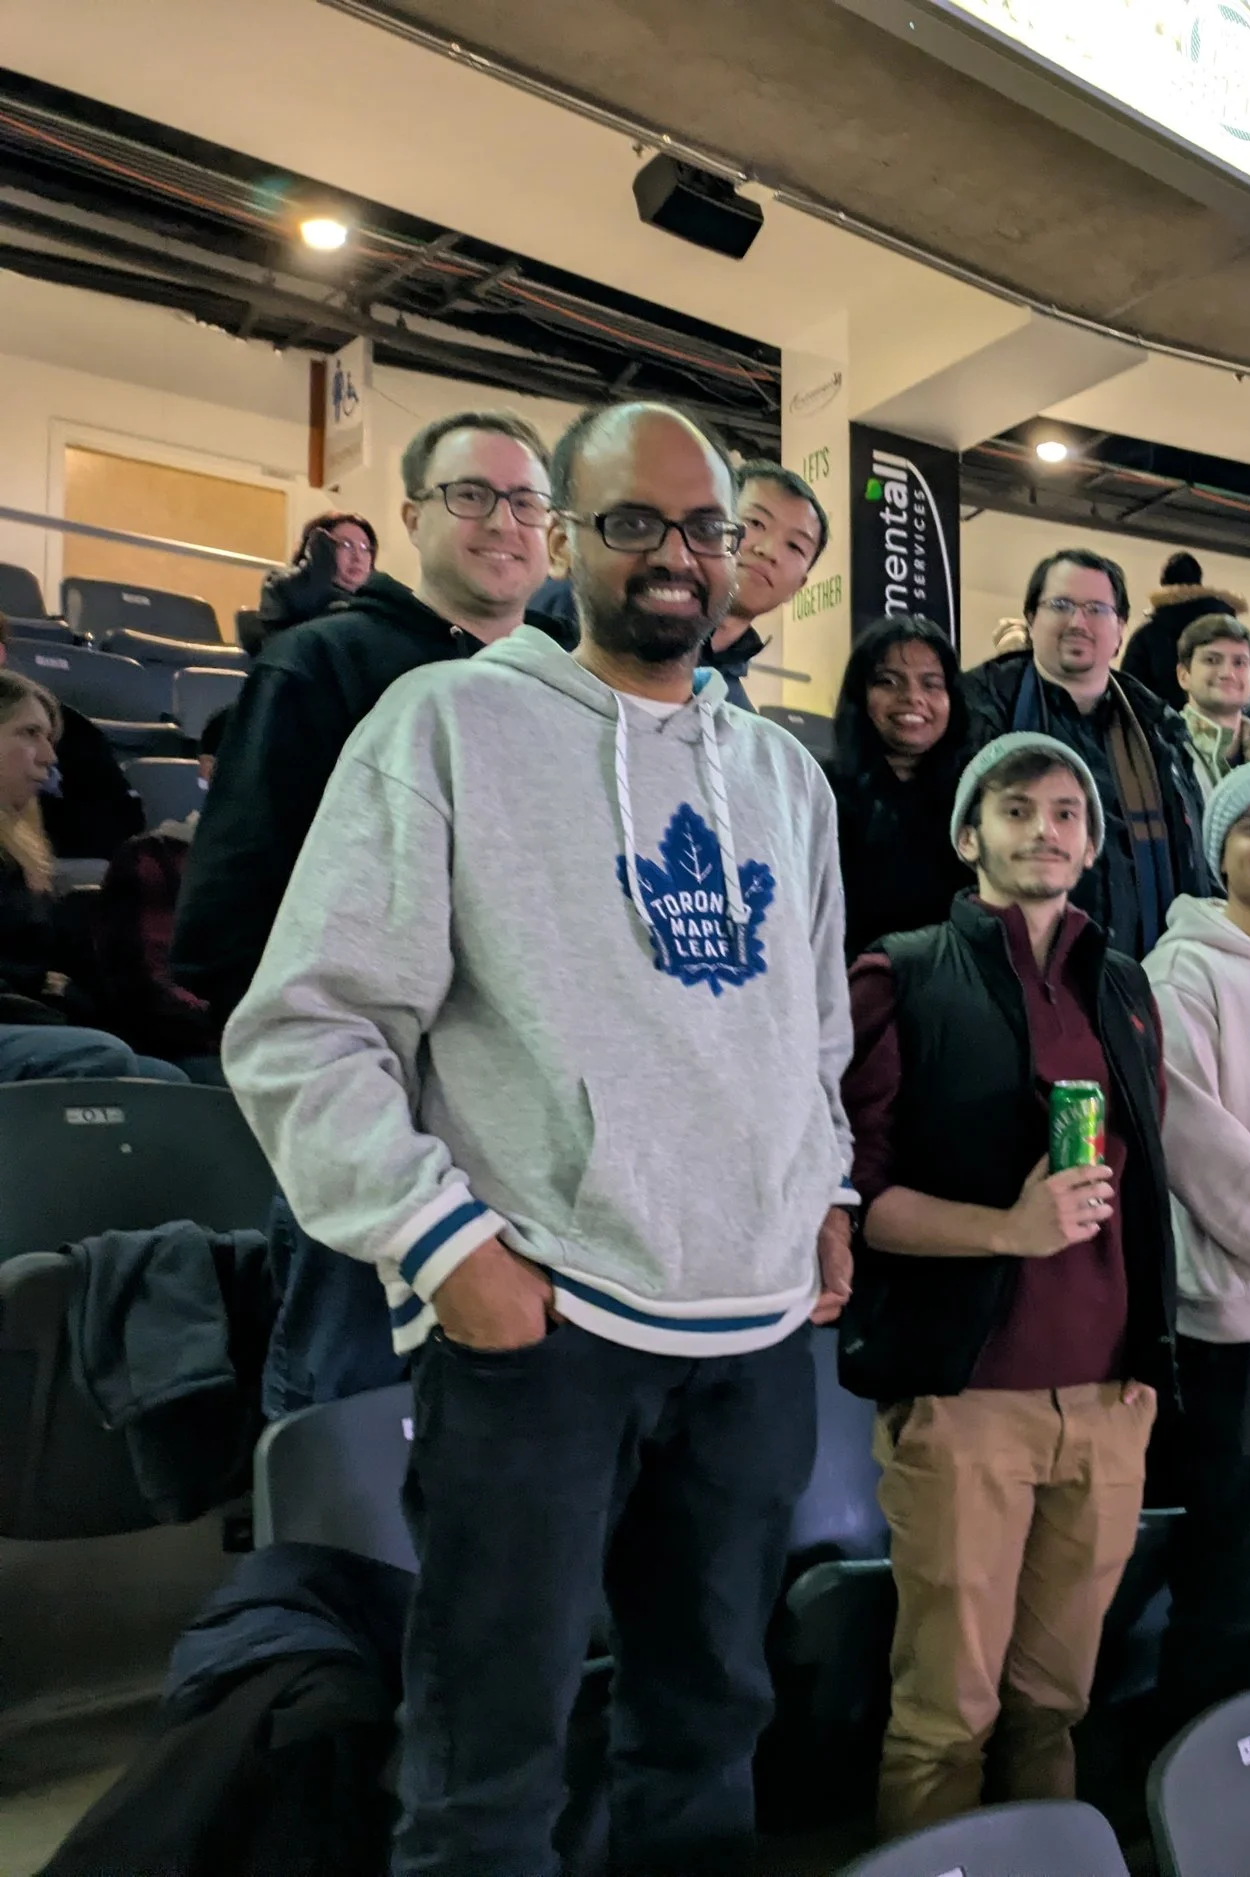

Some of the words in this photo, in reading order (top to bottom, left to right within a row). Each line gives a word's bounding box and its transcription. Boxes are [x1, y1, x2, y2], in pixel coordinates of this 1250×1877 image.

[912, 489, 927, 600] SERVICES
[792, 574, 842, 622] TOGETHER
[650, 890, 724, 919] TORON
[670, 917, 728, 938] MAPL
[674, 939, 730, 957] LEAF
